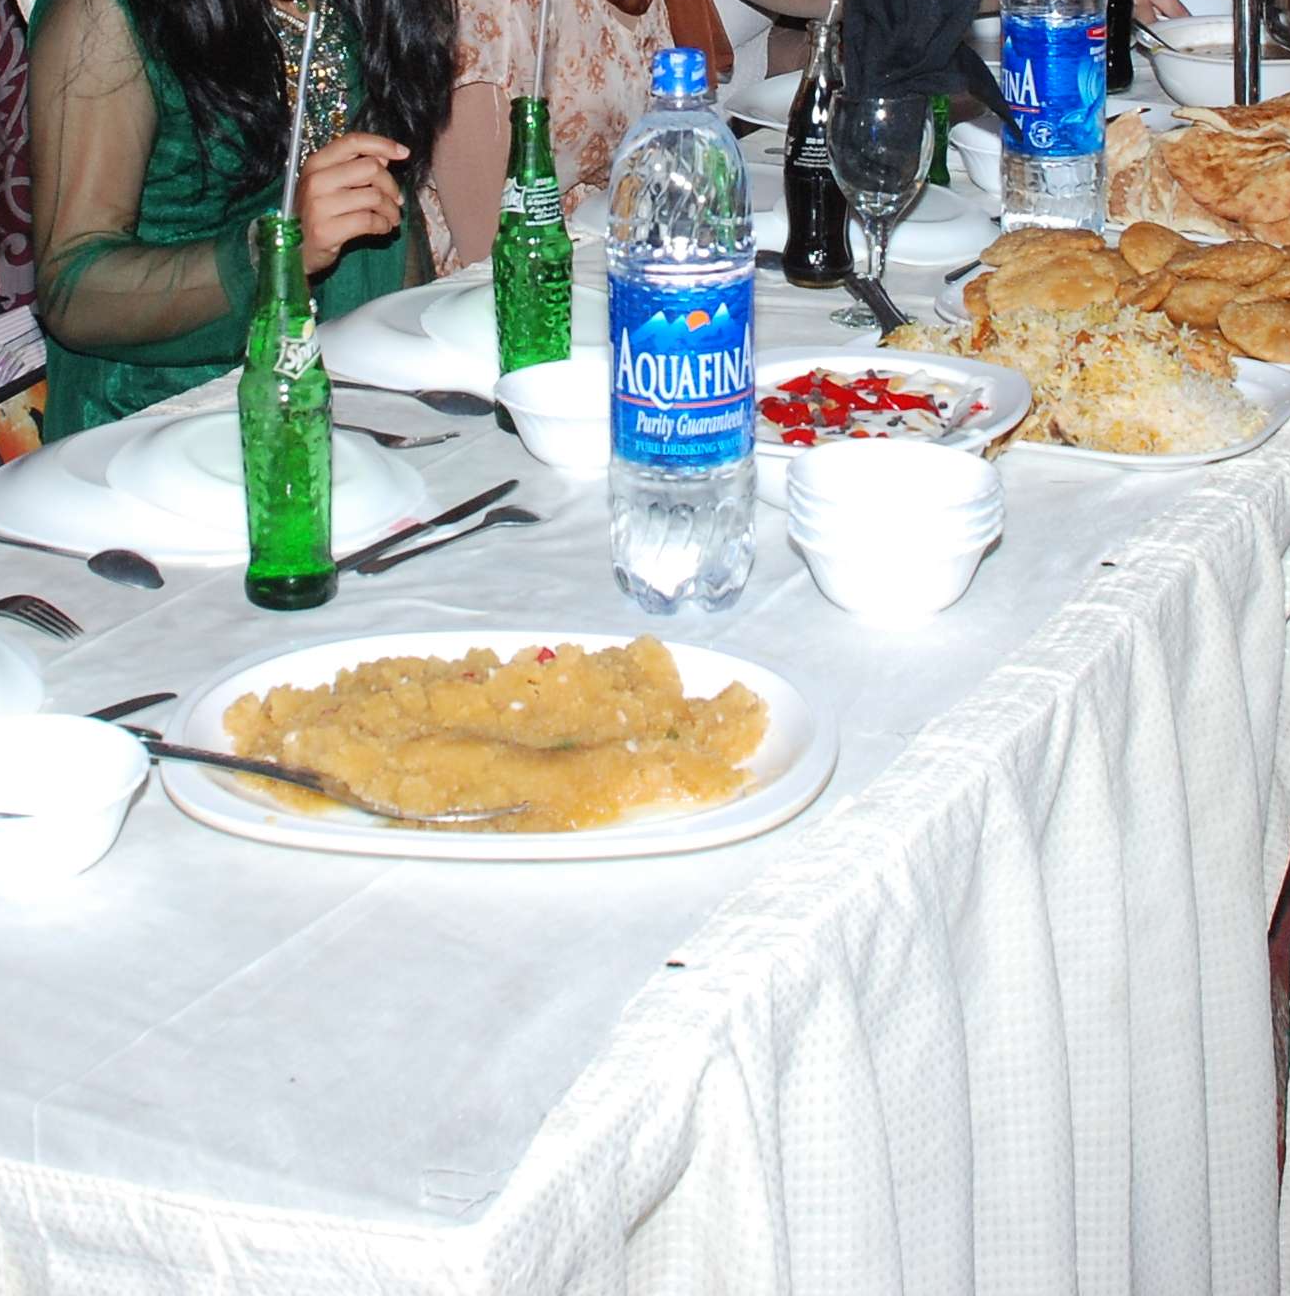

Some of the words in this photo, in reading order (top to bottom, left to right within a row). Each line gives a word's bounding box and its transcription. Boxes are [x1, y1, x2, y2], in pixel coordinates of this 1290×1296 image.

[616, 322, 754, 410] AQUAFINA
[635, 410, 675, 442] Purity
[676, 402, 745, 436] Guaranteed
[662, 440, 717, 455] DRINKING
